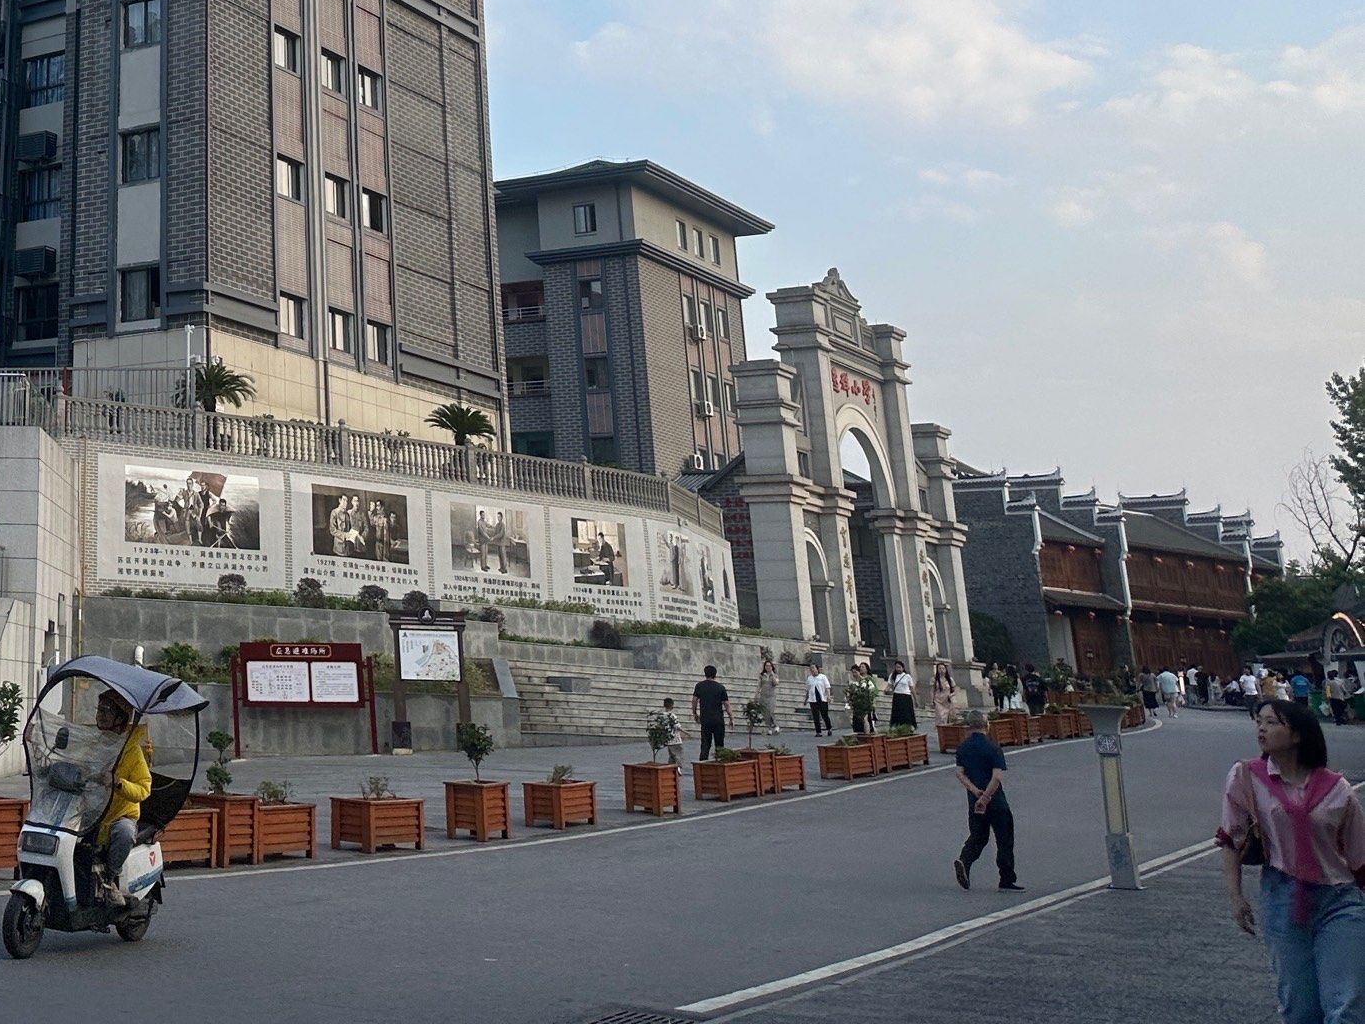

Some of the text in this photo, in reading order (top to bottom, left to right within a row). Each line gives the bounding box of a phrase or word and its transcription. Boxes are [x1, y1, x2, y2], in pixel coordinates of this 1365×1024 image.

[275, 647, 326, 655] 应急避难场所
